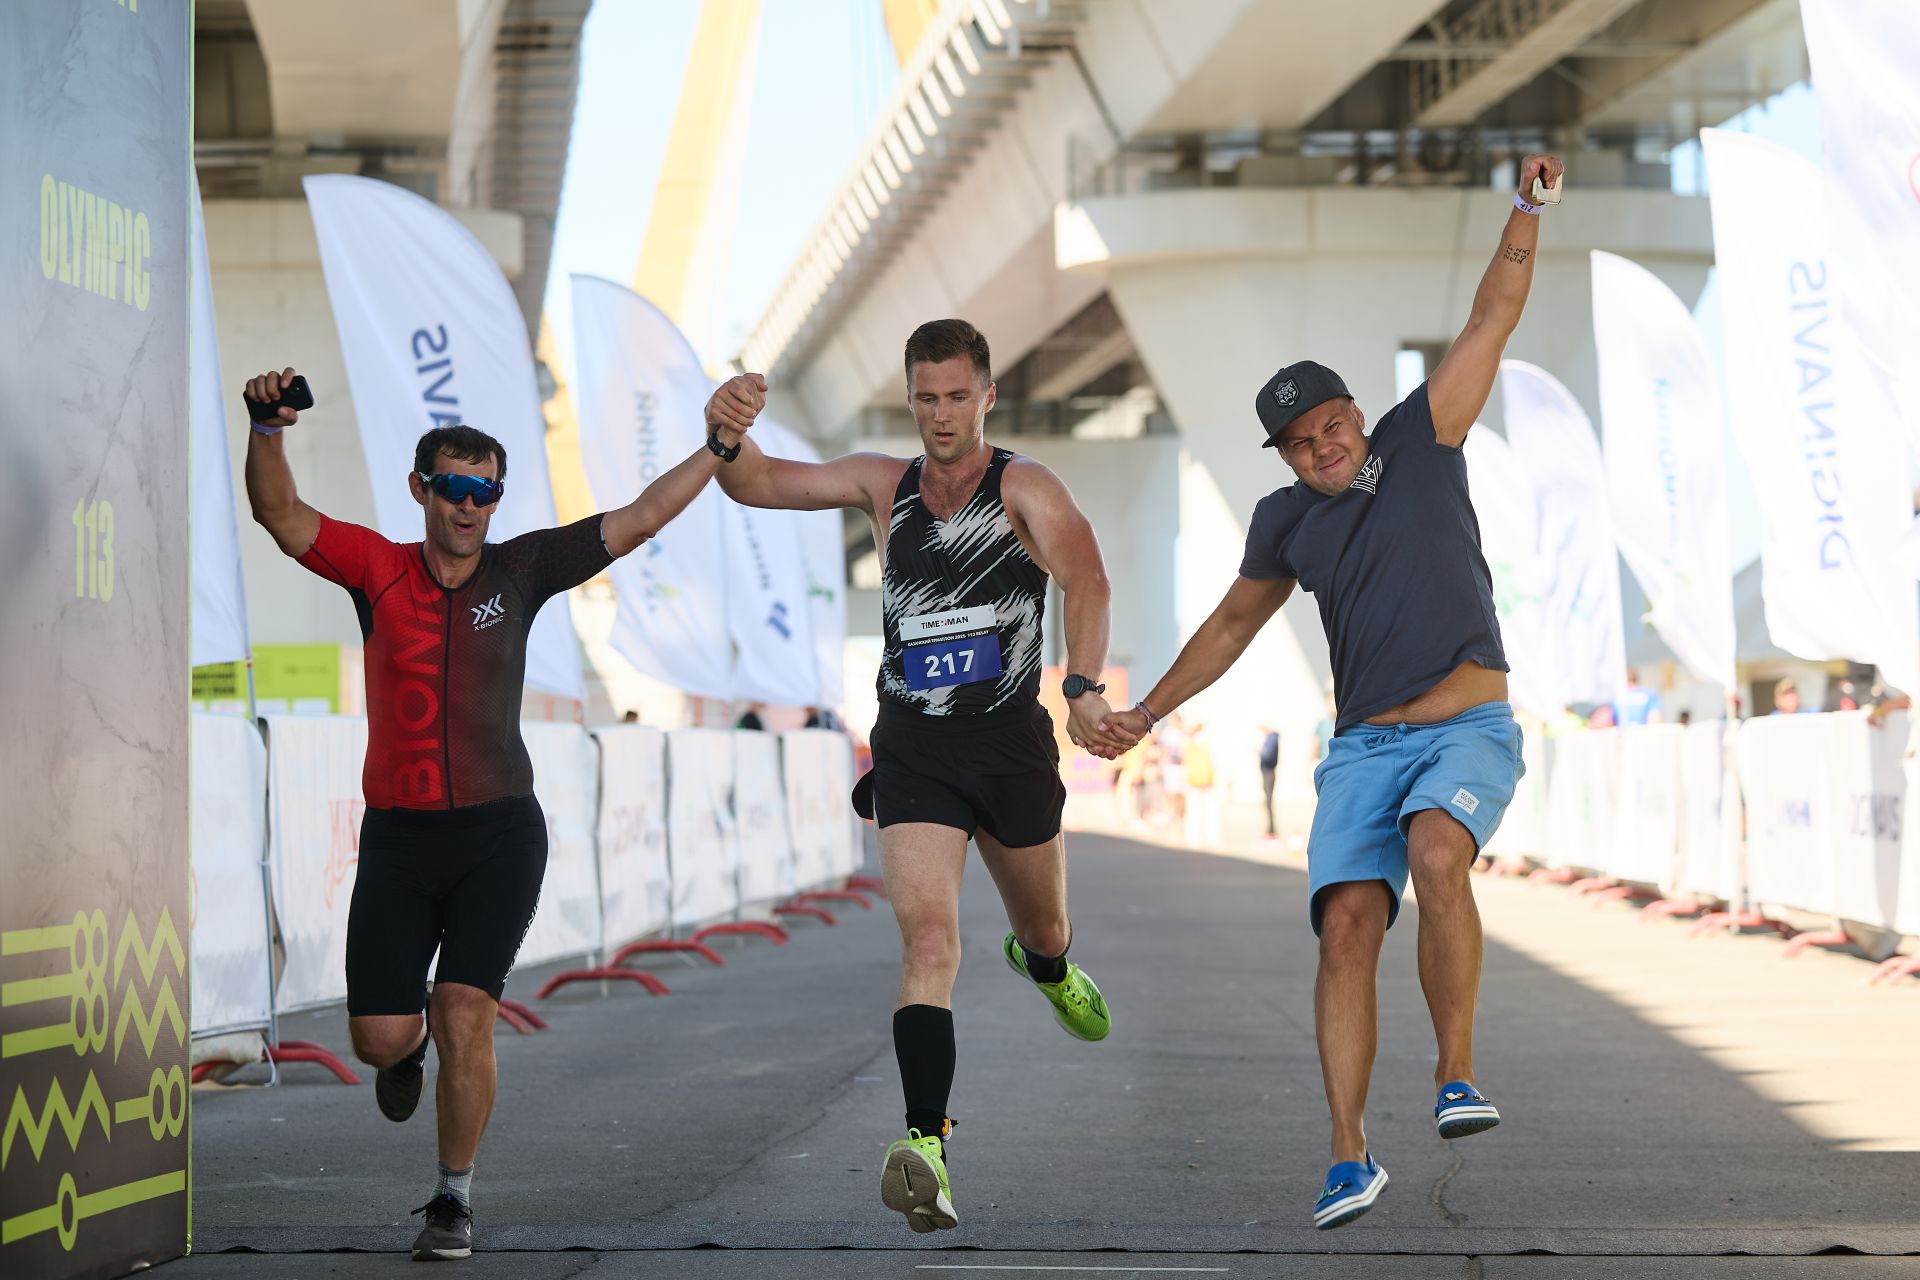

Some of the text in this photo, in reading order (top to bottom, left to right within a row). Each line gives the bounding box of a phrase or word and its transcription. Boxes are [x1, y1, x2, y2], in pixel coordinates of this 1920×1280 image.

[41, 174, 150, 311] OLYMPIC
[73, 497, 114, 602] 113
[474, 615, 504, 631] X-BIONIC
[924, 649, 975, 678] 217
